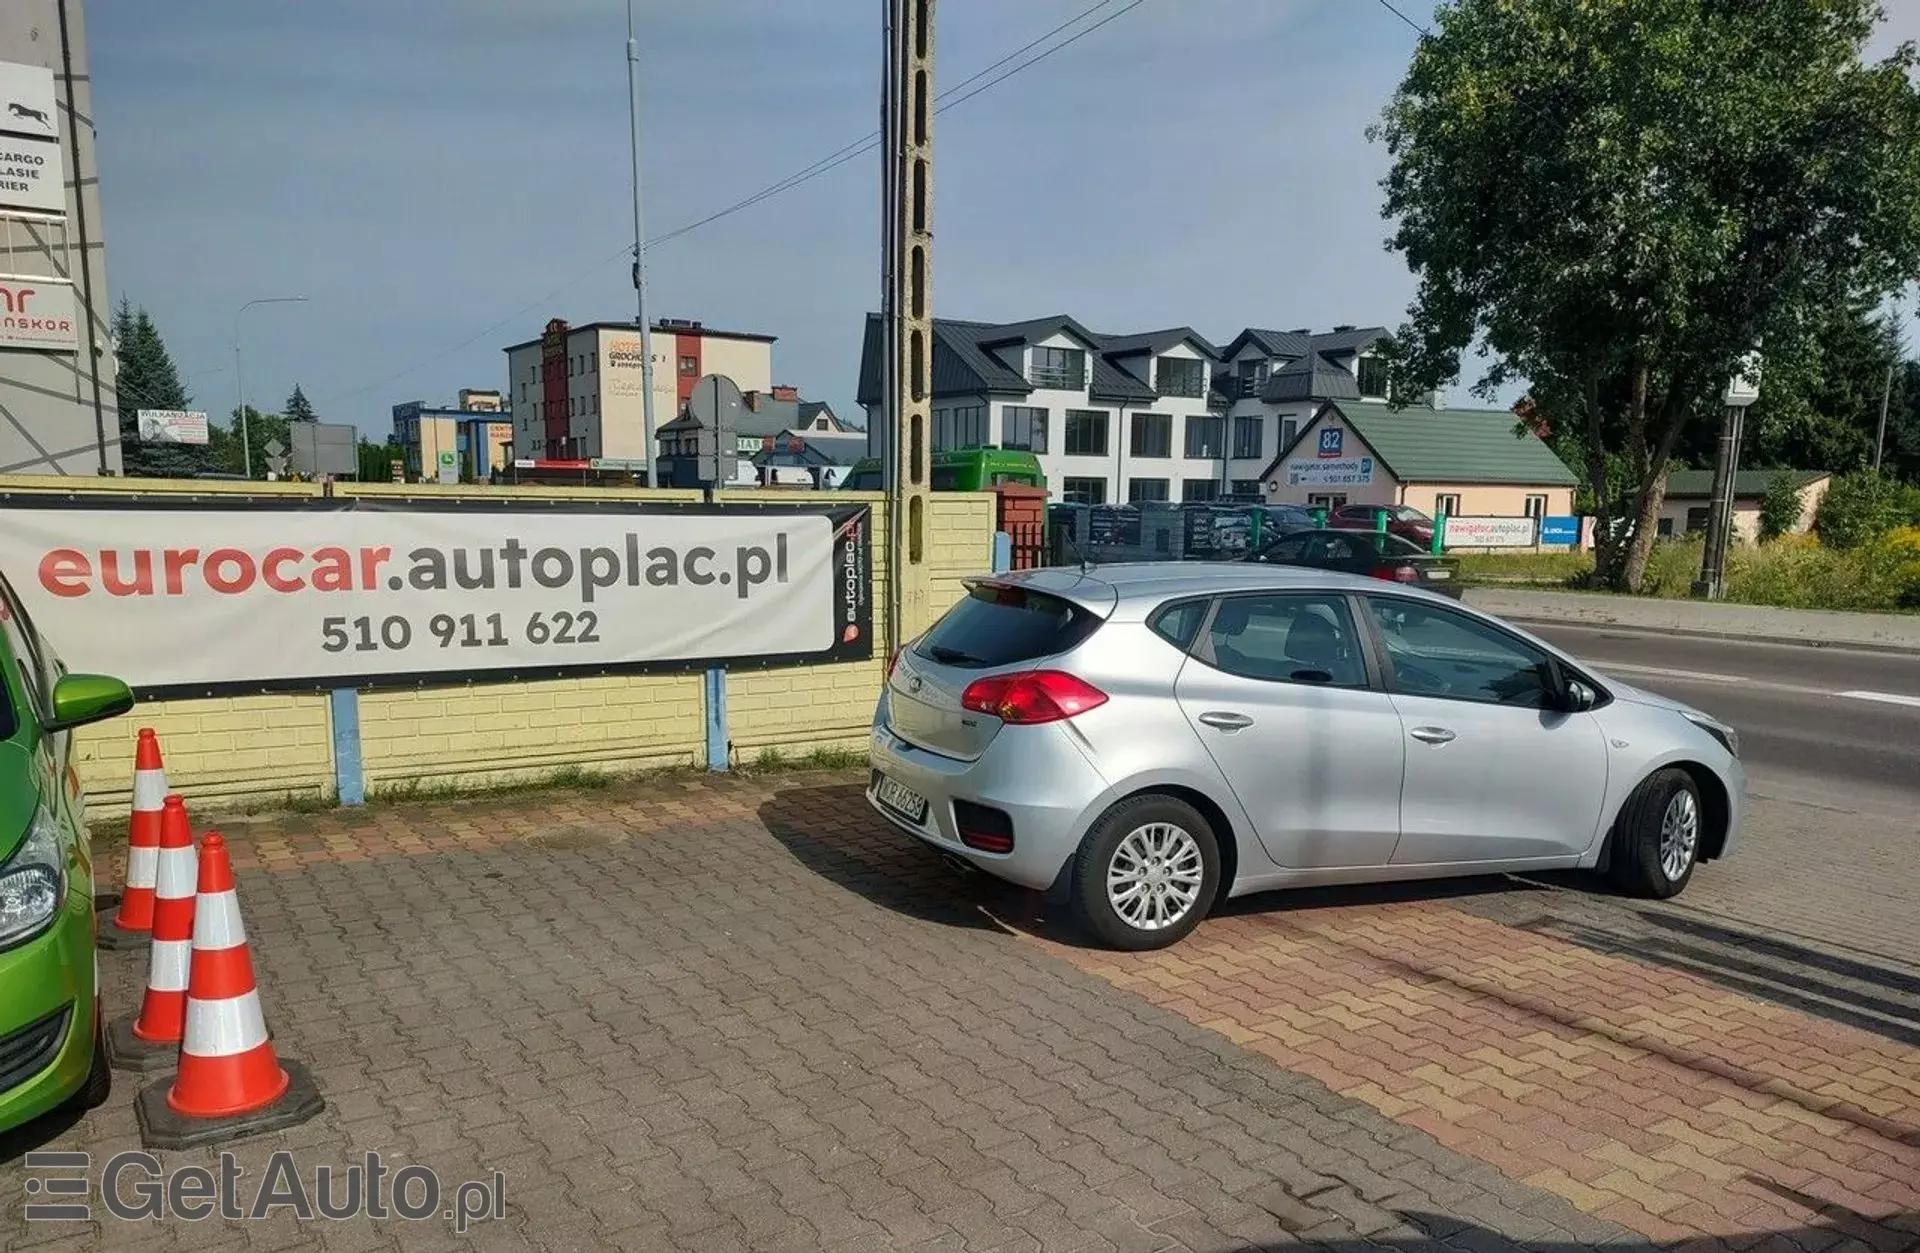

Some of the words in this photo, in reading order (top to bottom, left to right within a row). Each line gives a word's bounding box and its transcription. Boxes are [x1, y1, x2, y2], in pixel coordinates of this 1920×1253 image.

[1322, 431, 1340, 449] 82
[38, 532, 789, 602] eurocar.autoplac.pl
[321, 613, 412, 653] 510
[429, 613, 508, 650] 911
[526, 611, 600, 645] 622
